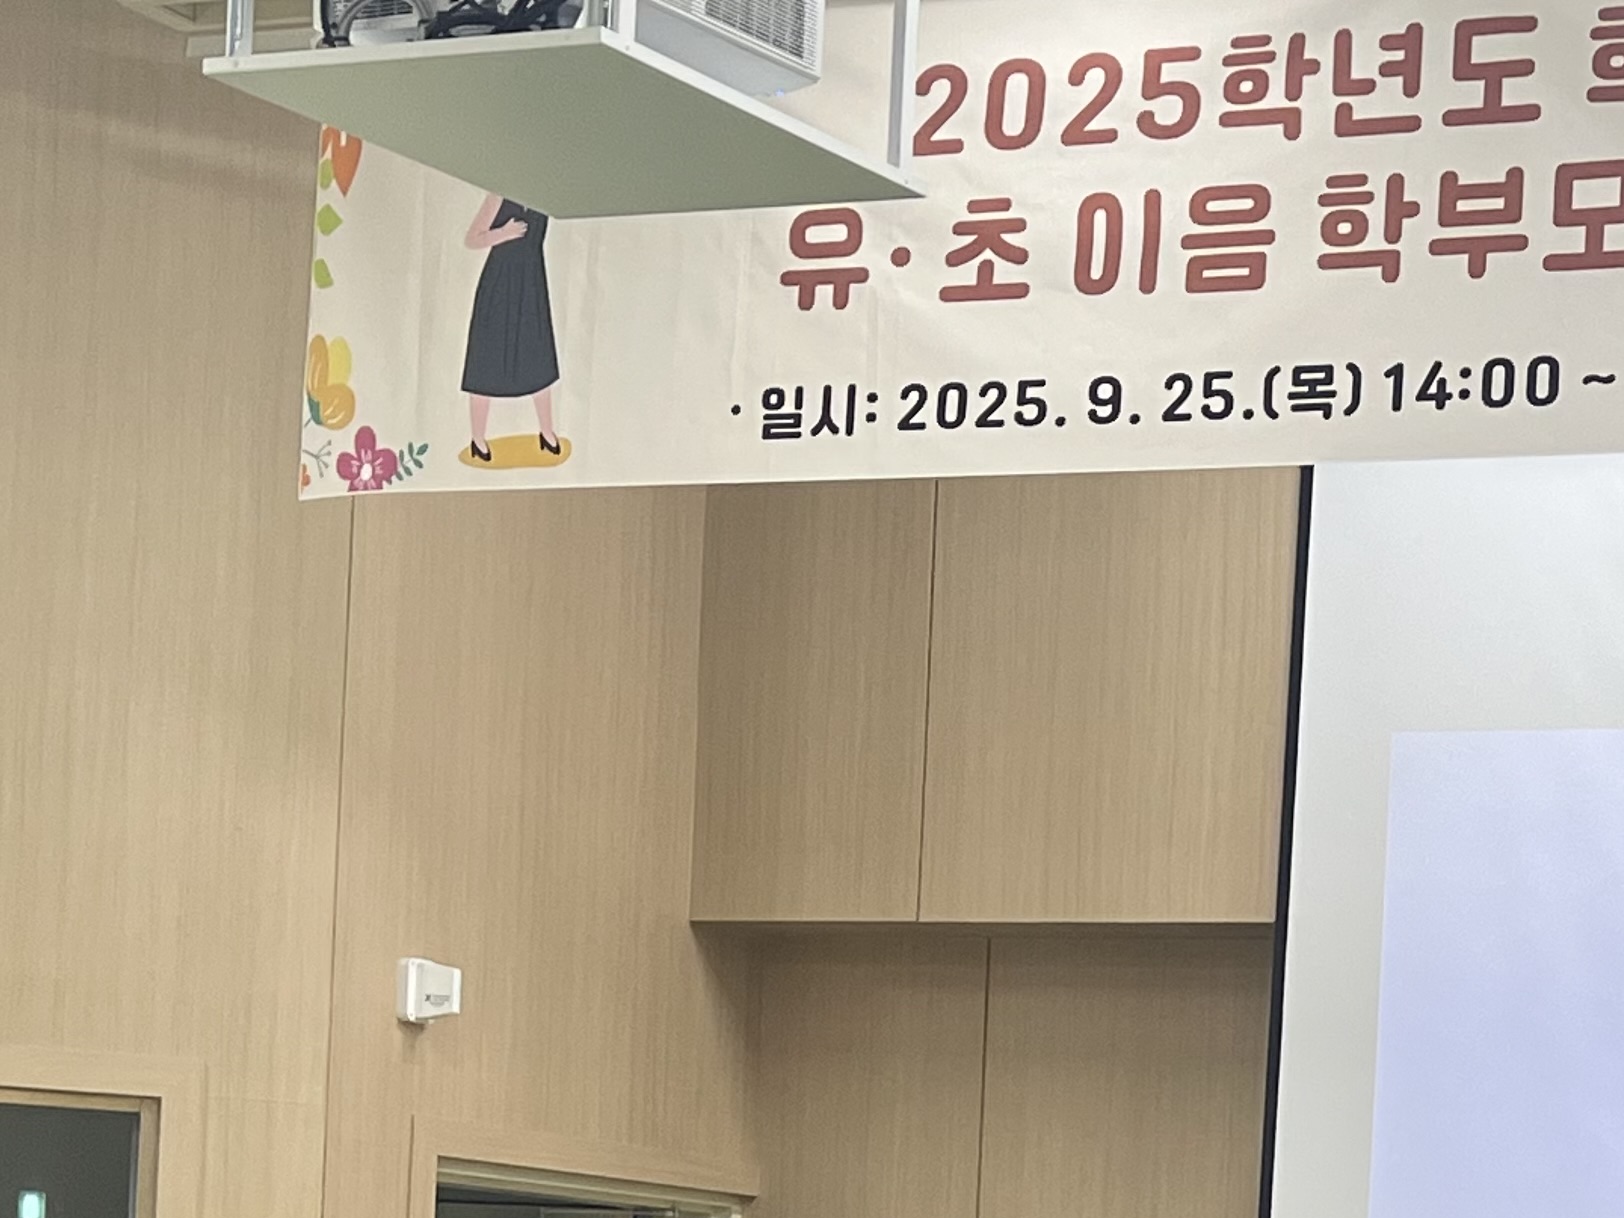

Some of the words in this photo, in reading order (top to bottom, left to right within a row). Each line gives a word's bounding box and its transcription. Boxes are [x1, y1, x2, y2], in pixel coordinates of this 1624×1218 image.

[912, 14, 1543, 157] 2025학년도
[1072, 184, 1277, 296] 이음
[760, 383, 879, 441] 일시:
[896, 379, 1067, 432] 2025.
[1086, 375, 1142, 426] 9.
[1382, 355, 1561, 414] 14:00
